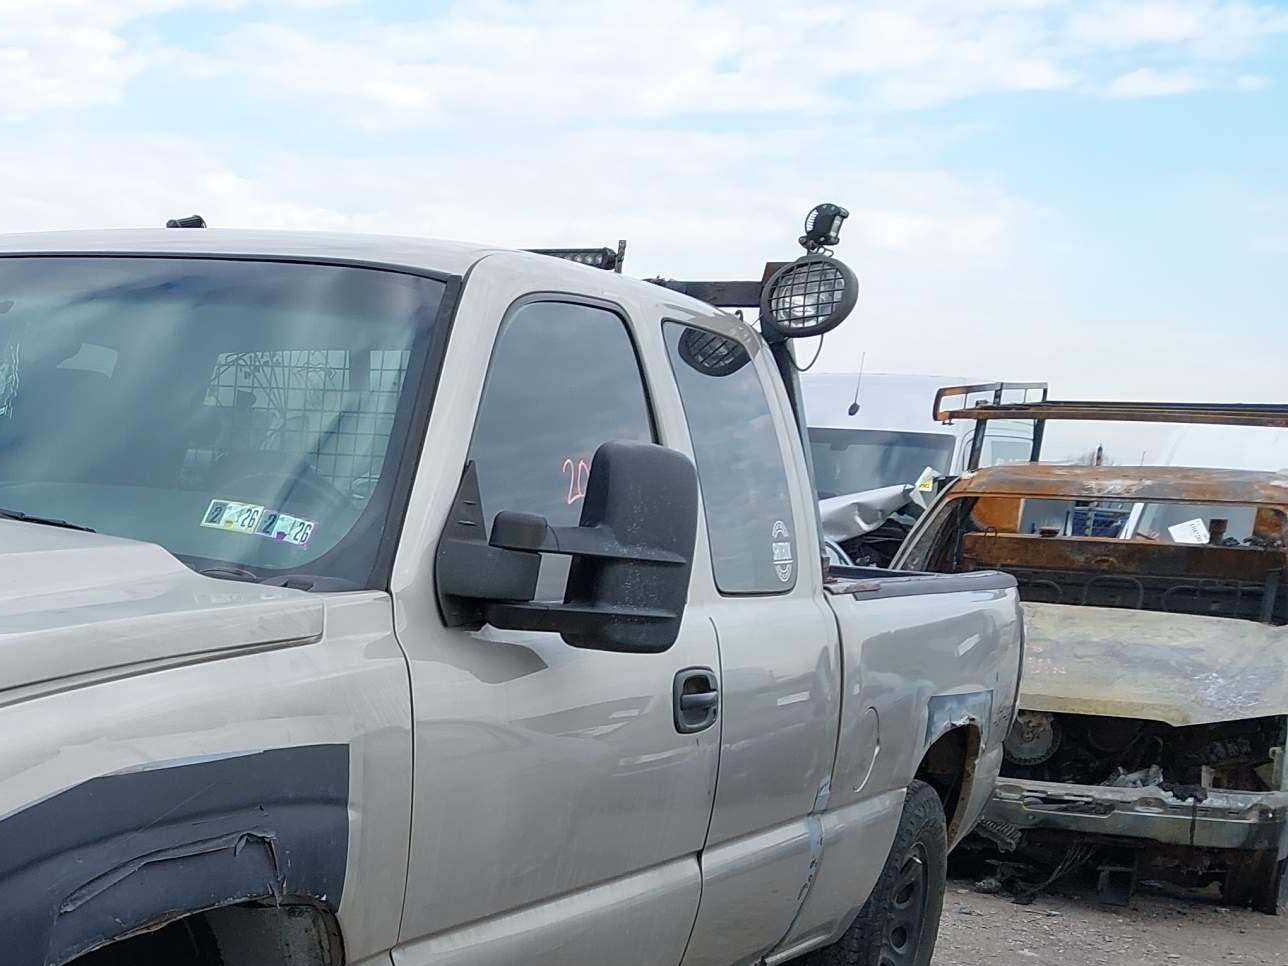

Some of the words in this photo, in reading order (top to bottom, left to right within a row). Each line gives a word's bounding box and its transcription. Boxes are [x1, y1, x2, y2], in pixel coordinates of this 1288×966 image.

[209, 506, 223, 523] 2
[240, 508, 260, 529] 26
[262, 513, 278, 534] 2
[293, 521, 312, 543] 26
